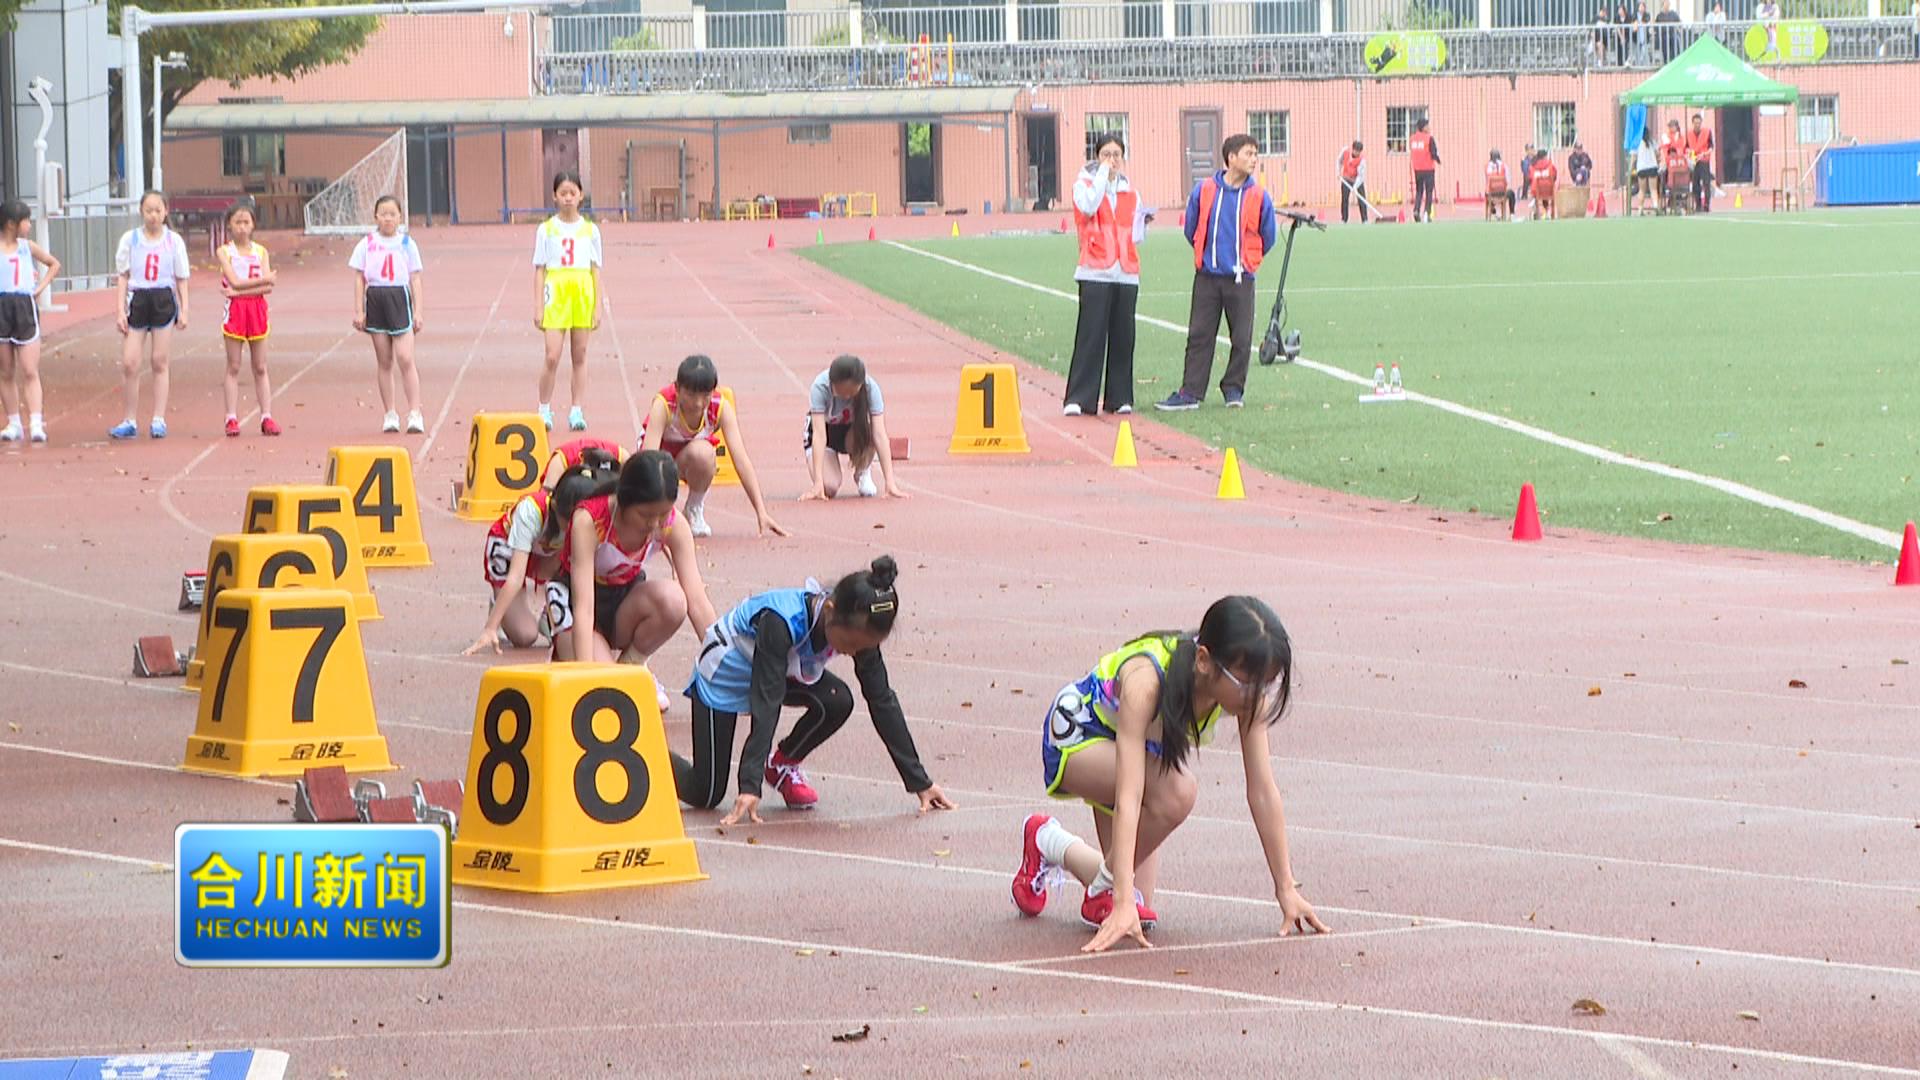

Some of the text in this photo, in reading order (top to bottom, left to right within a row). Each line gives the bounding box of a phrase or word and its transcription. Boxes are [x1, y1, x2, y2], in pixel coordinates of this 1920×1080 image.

[9, 257, 19, 287] 7
[144, 253, 160, 282] 6
[381, 253, 395, 282] 4
[561, 238, 575, 266] 3
[970, 373, 994, 428] 1
[466, 423, 479, 490] 3
[494, 423, 539, 490] 3
[353, 457, 402, 533] 4
[298, 498, 348, 580] 5
[489, 541, 512, 577] 5
[212, 606, 250, 723] 7
[269, 606, 347, 724] 7
[477, 687, 532, 826] 8
[571, 687, 650, 825] 8
